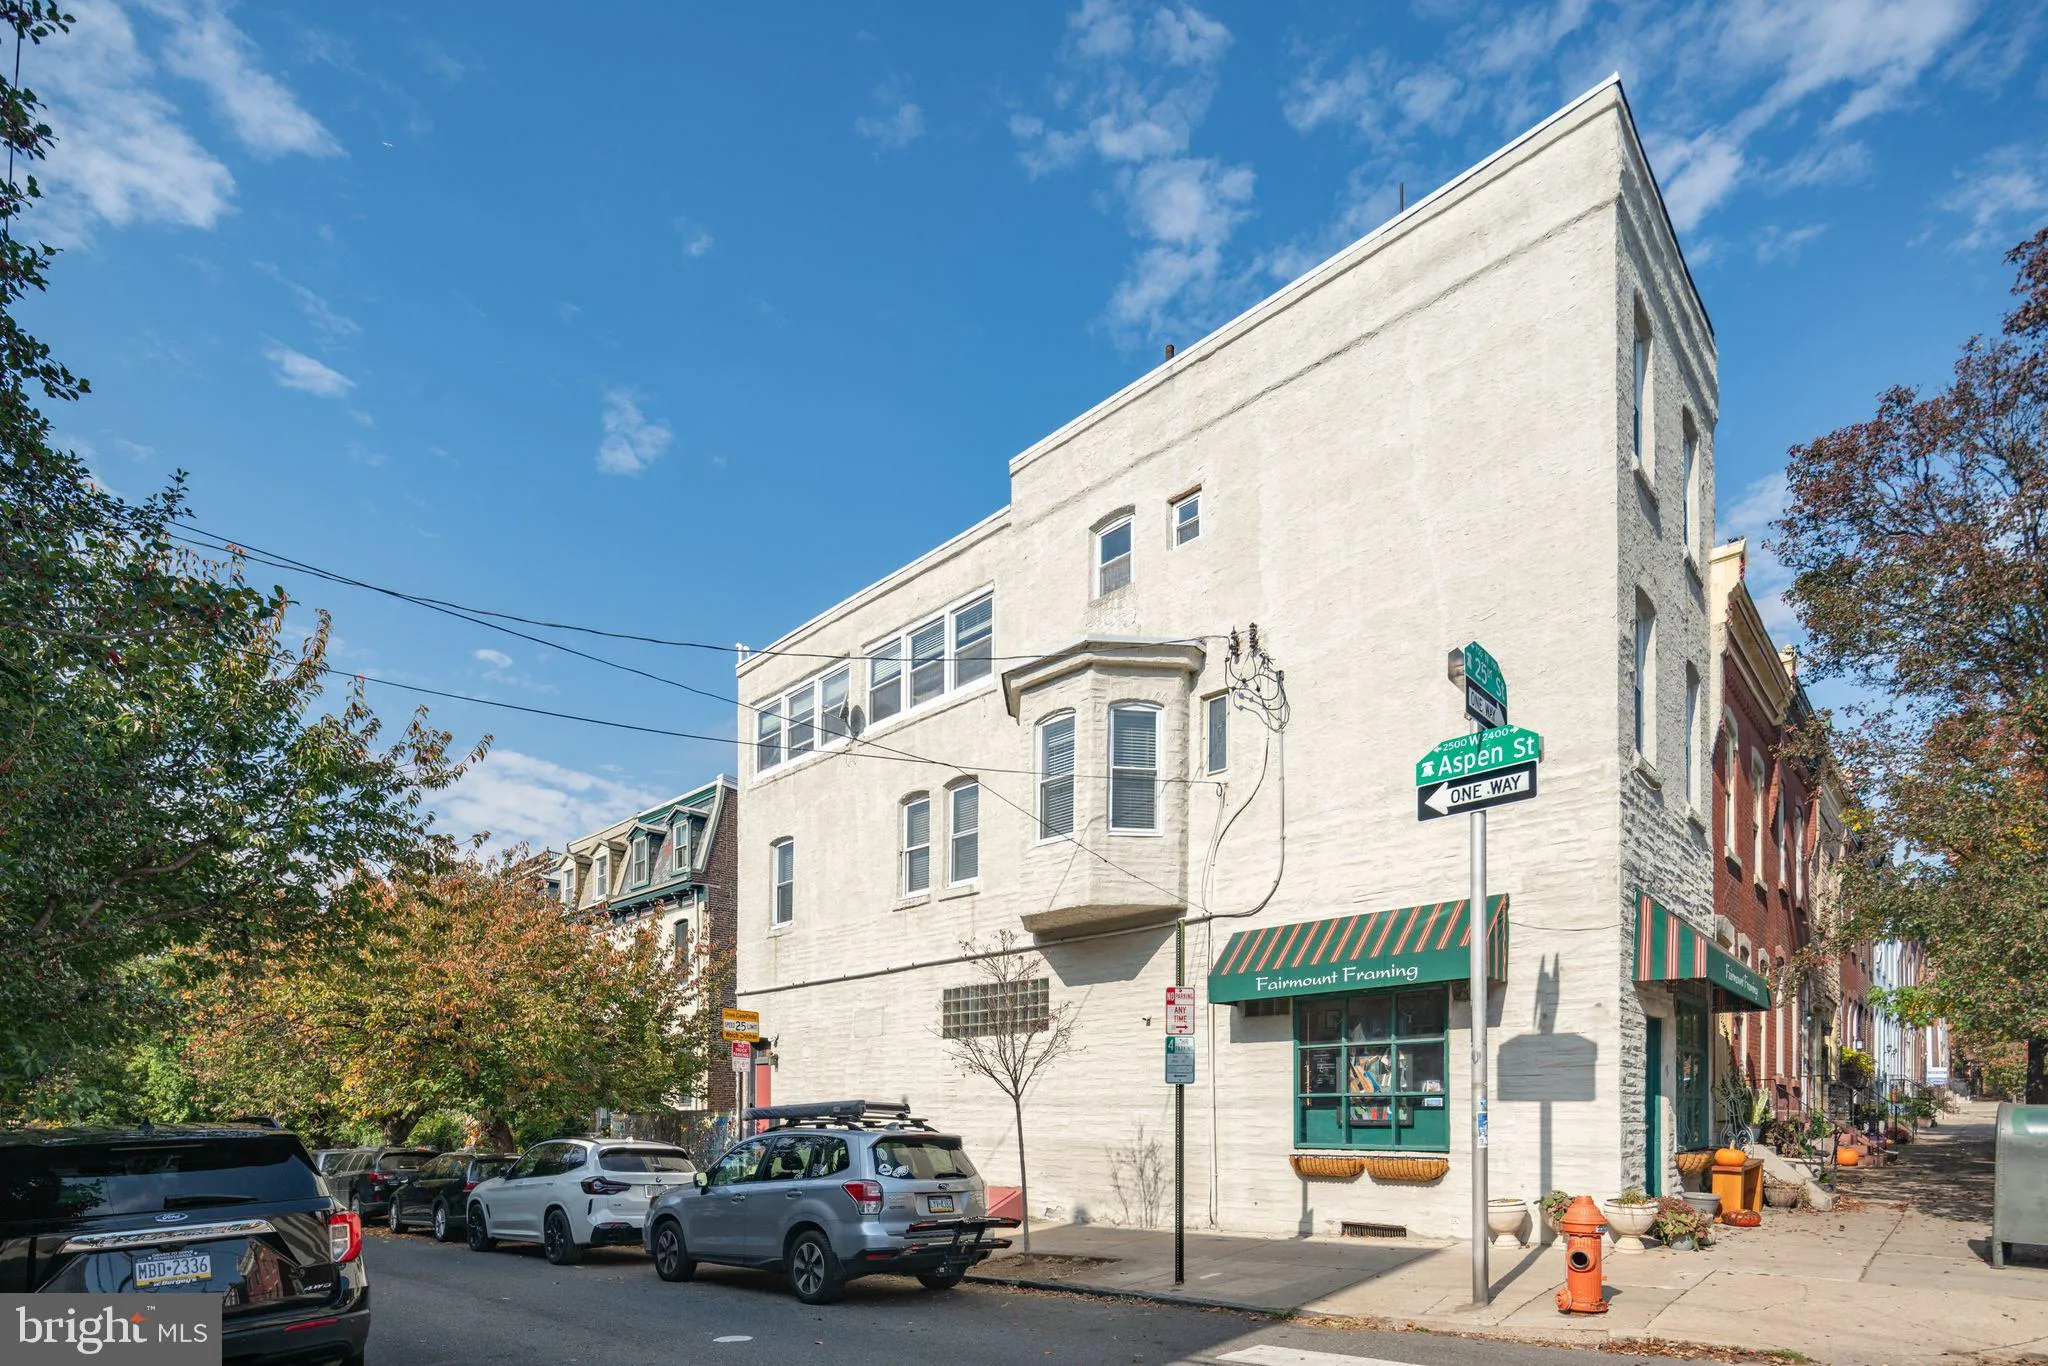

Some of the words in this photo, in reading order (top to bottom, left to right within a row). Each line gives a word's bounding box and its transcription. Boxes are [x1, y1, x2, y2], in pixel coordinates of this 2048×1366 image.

[1495, 676, 1506, 701] St
[1471, 691, 1483, 712] ONE
[1485, 703, 1497, 723] WAY
[1442, 738, 1467, 752] 2500
[1468, 734, 1480, 746] W
[1482, 728, 1509, 742] 2400
[1437, 743, 1503, 776] Aspen
[1513, 736, 1535, 759] St
[1451, 783, 1482, 803] ONE
[1490, 775, 1522, 795] WAY
[1255, 970, 1338, 992] Fairmount
[1342, 963, 1419, 981] Framing
[1166, 991, 1174, 1002] NO
[1173, 1015, 1187, 1023] TIME
[1174, 1006, 1187, 1014] ANY
[736, 1021, 746, 1031] 25
[1168, 1039, 1174, 1051] 4
